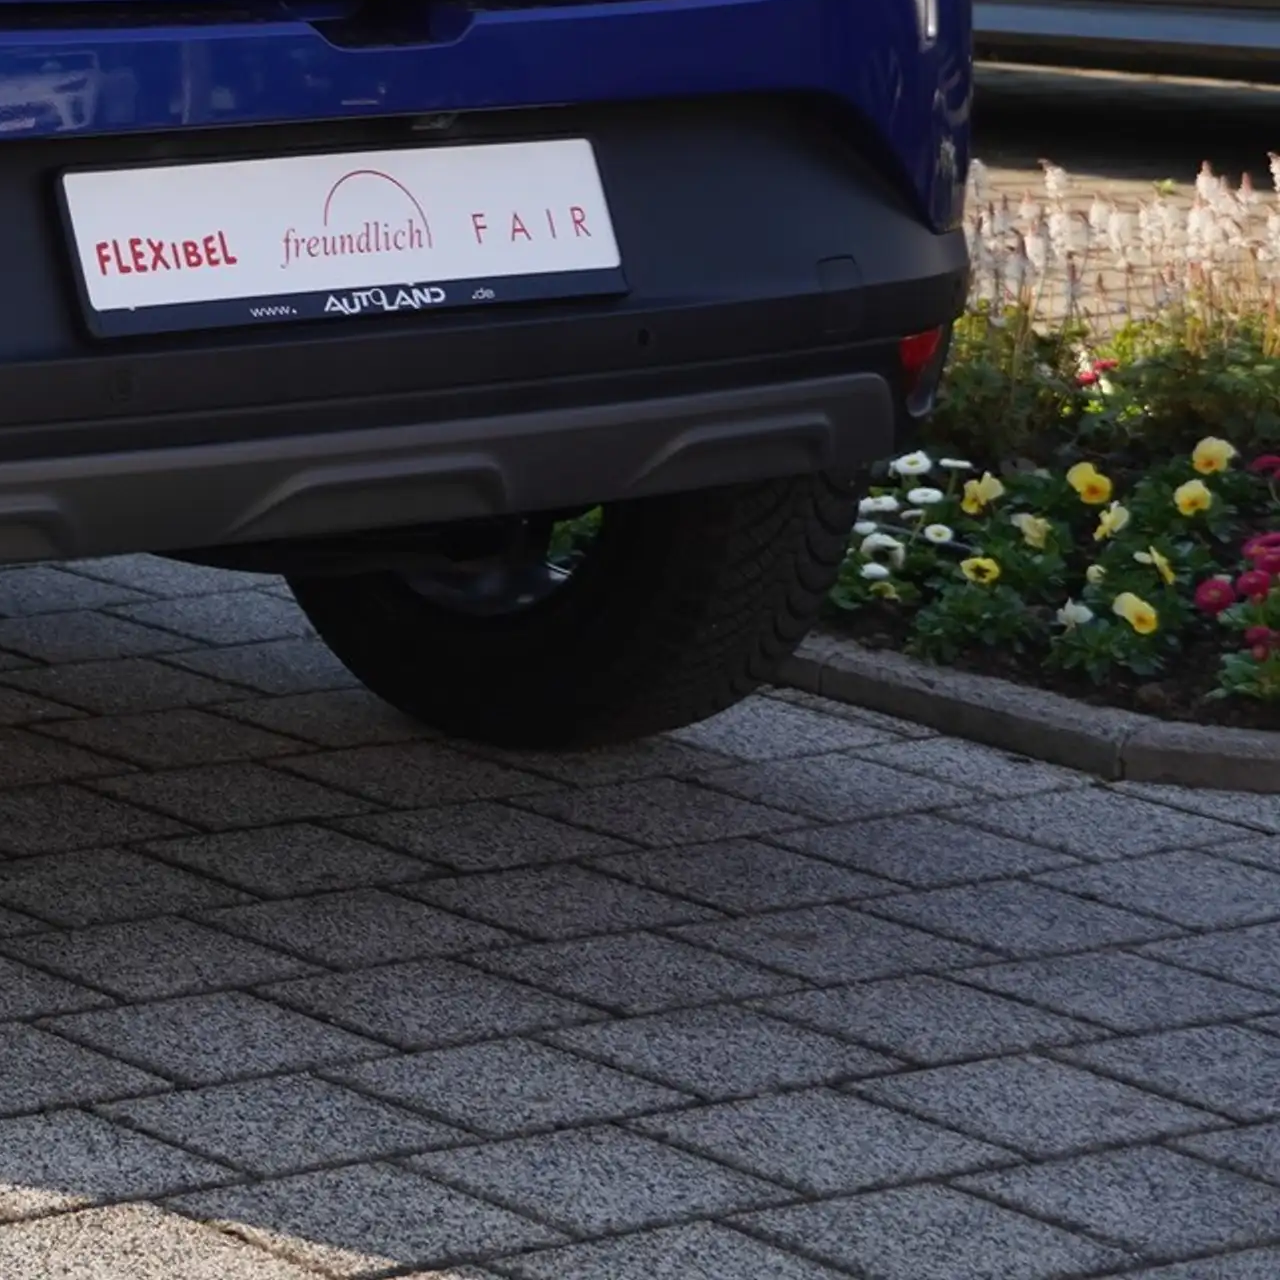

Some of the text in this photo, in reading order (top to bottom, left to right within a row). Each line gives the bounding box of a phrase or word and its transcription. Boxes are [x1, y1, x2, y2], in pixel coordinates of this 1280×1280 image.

[95, 231, 238, 276] FLEXIBEL
[280, 218, 424, 269] freundlich
[250, 286, 495, 318] www. AUTOLAND .de
